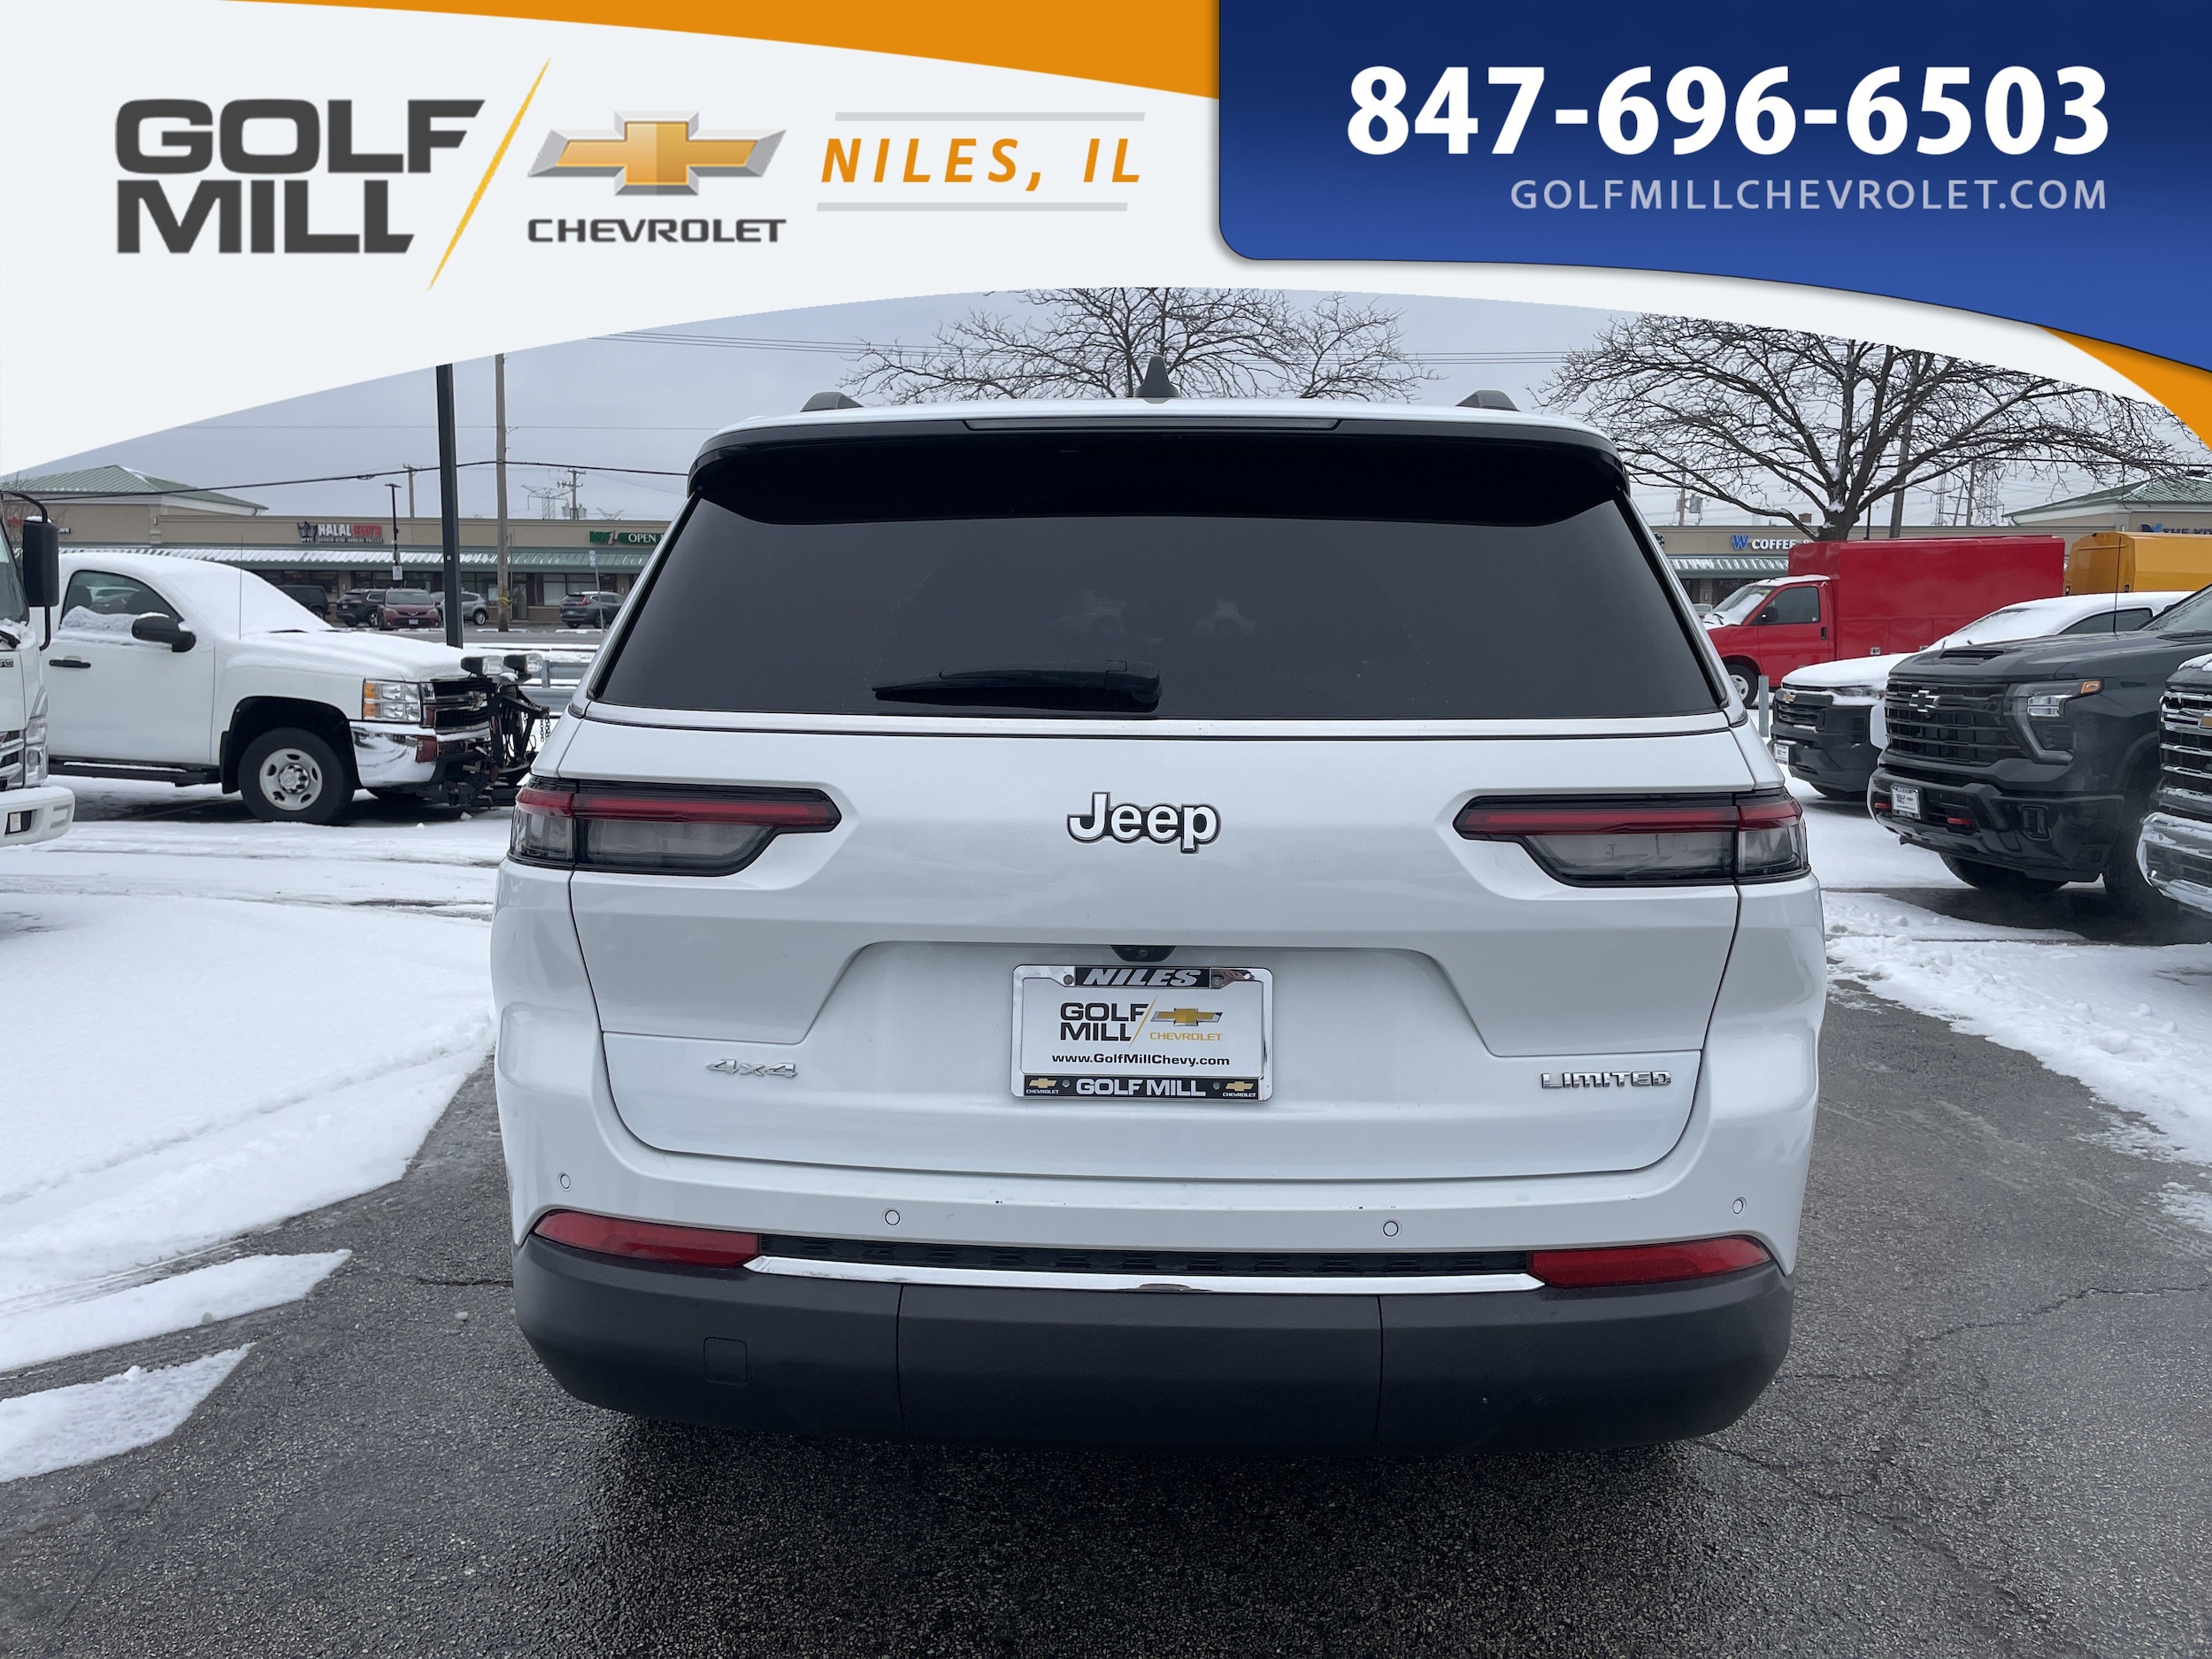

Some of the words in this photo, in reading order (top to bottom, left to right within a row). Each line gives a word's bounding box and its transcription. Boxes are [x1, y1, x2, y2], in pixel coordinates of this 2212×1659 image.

[319, 524, 351, 536] HALAL
[628, 534, 657, 543] OPEN
[1732, 534, 1749, 549] W
[1067, 792, 1221, 854] Jeep
[1082, 968, 1202, 987] NILES
[1060, 1002, 1149, 1022] GOLF
[1060, 1023, 1133, 1041] MILL
[1149, 1032, 1223, 1041] CHEVROLET
[1052, 1053, 1230, 1067] www.GolfMillChevy.com
[1076, 1079, 1143, 1096] GOLF
[1147, 1079, 1206, 1096] MILL
[1541, 1071, 1671, 1088] LIMITED
